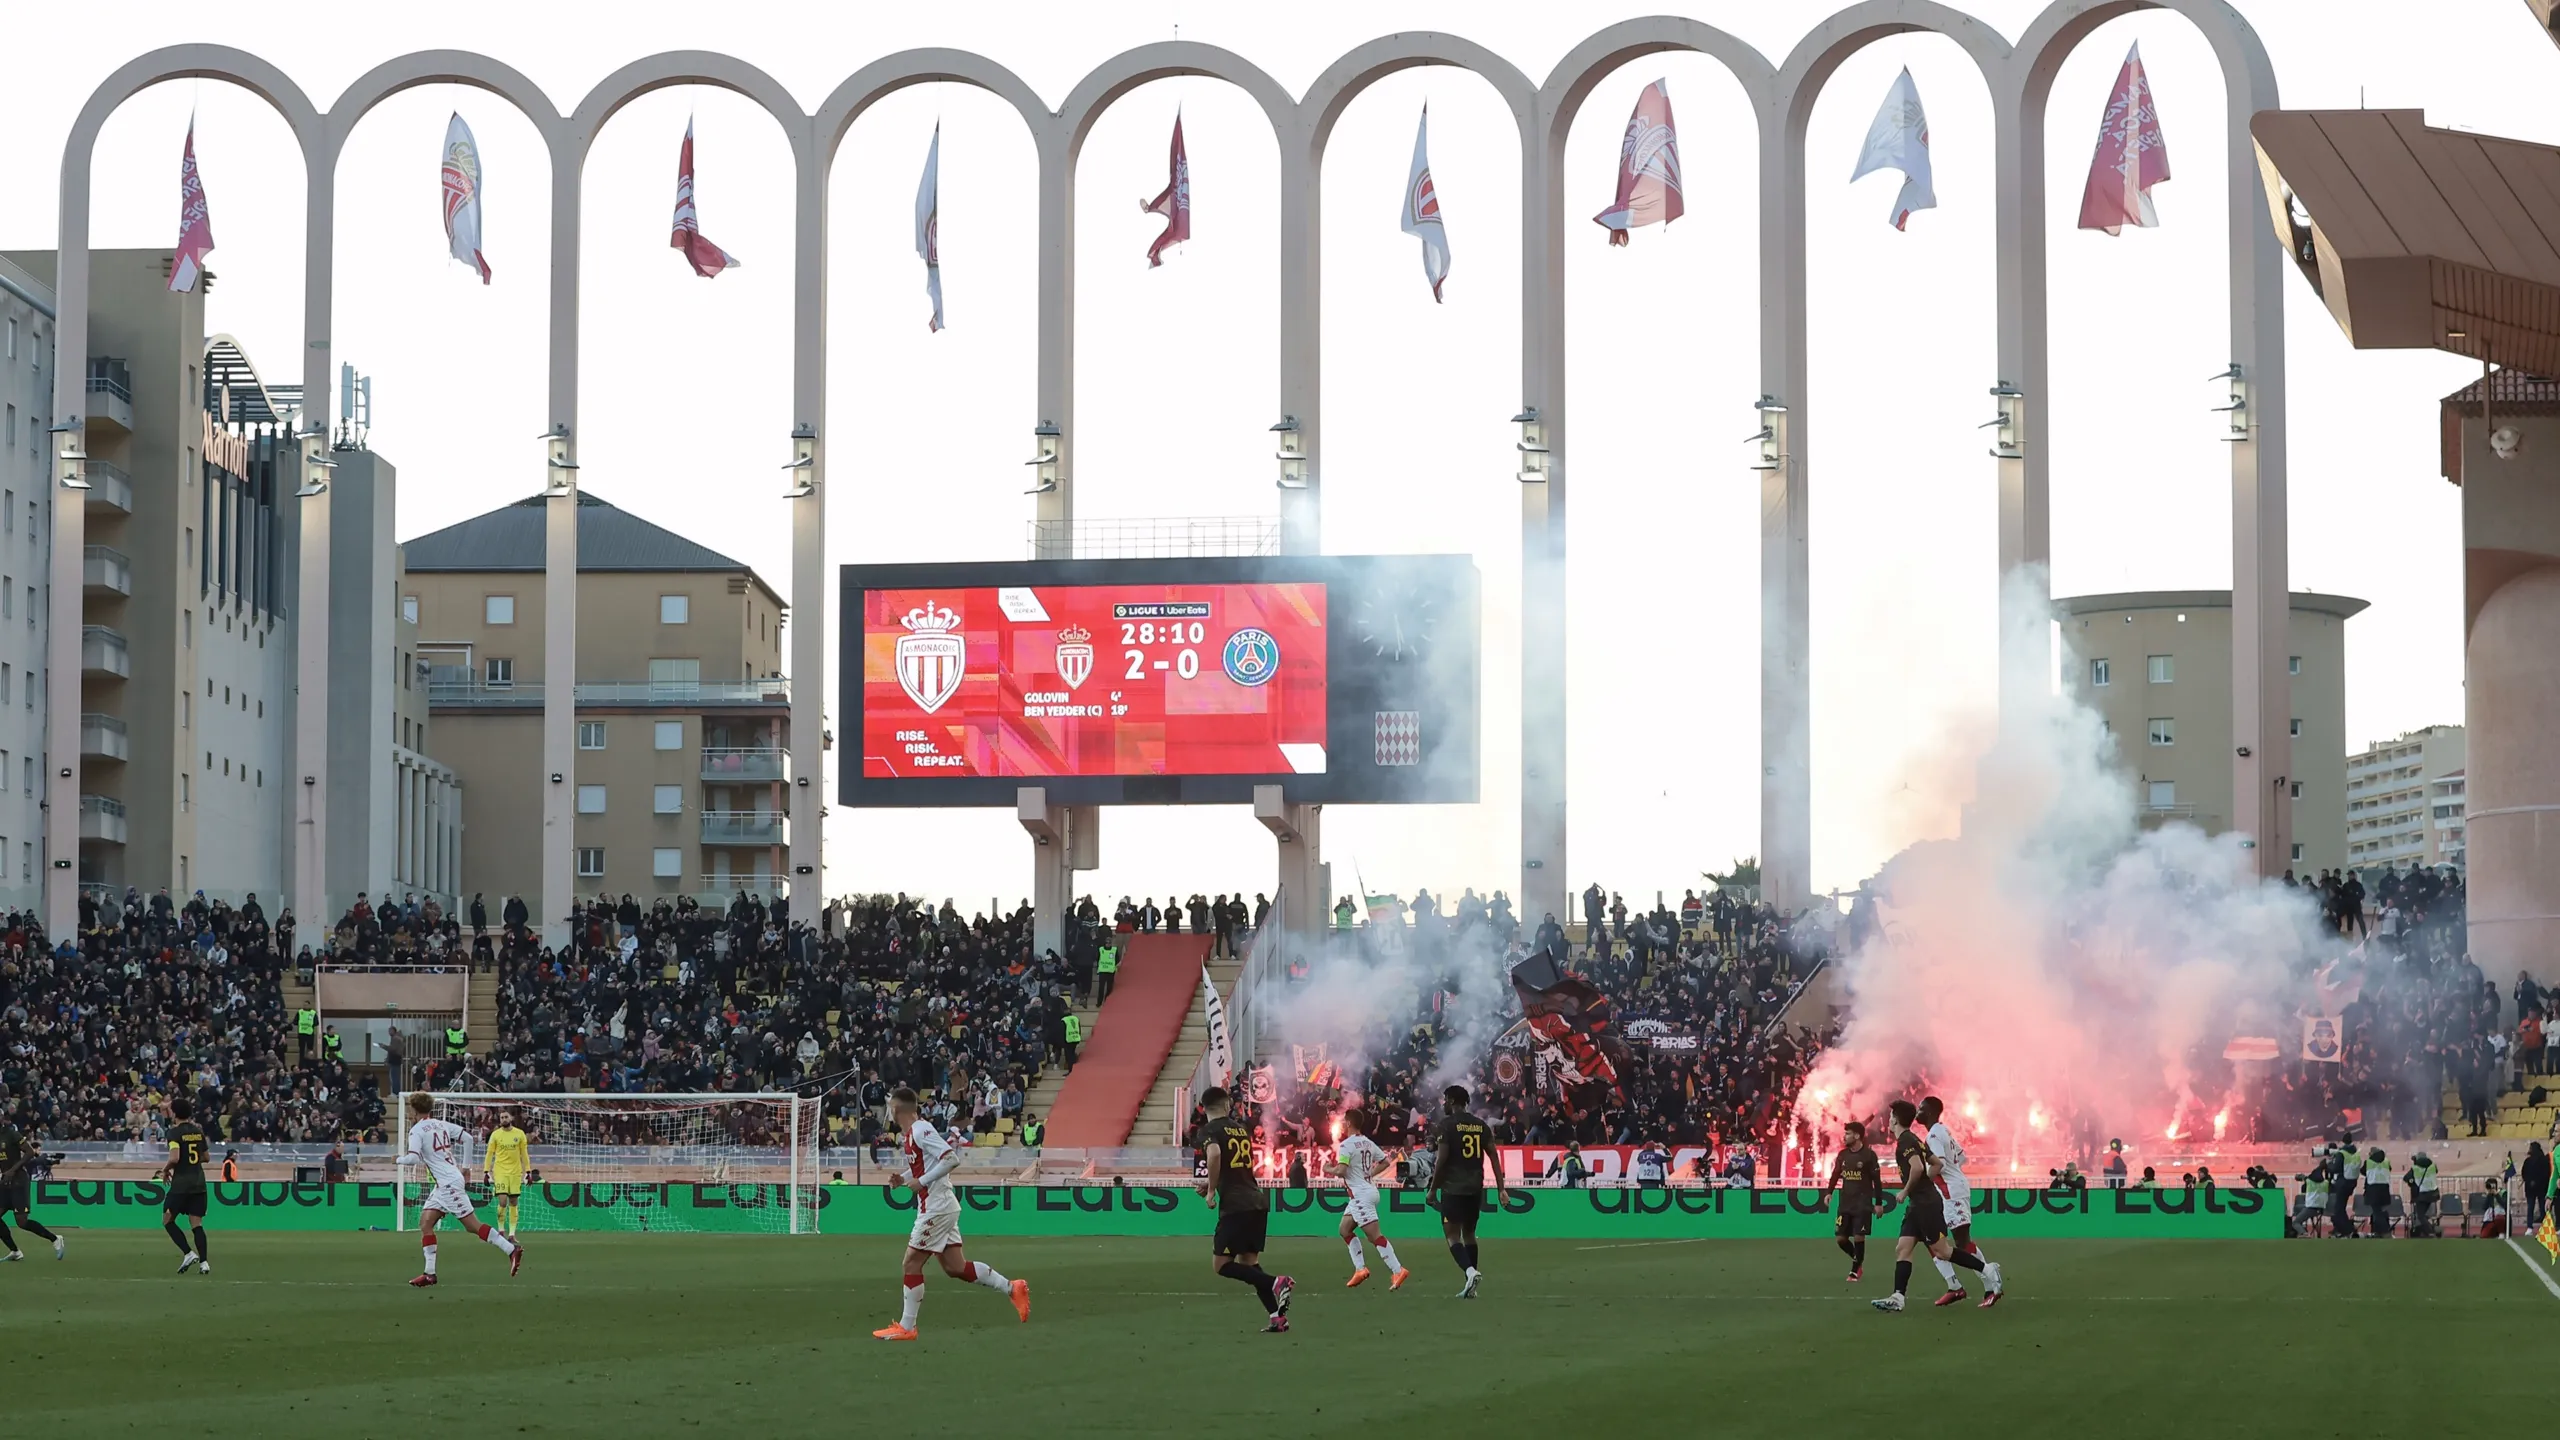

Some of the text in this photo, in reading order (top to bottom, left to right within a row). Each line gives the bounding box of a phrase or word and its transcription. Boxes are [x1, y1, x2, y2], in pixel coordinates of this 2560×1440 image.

[1128, 606, 1207, 615] LIGUE 1 Uber Eats
[1121, 622, 1205, 645] 28:10
[1232, 631, 1269, 646] PARIS
[913, 643, 949, 653] MONACO
[1024, 692, 1069, 703] GOLOVIN
[1024, 706, 1045, 717] BEN
[1087, 705, 1103, 717] (C)
[1110, 705, 1128, 716] 18'
[896, 730, 929, 742] RISE.
[905, 743, 939, 754] RISK.
[914, 756, 964, 767] REPEAT.
[432, 1130, 450, 1153] 44
[1462, 1134, 1481, 1158] 31
[188, 1143, 199, 1165] 5
[1228, 1138, 1252, 1169] 28
[1361, 1149, 1372, 1172] 10
[1841, 1170, 1862, 1178] QATAR
